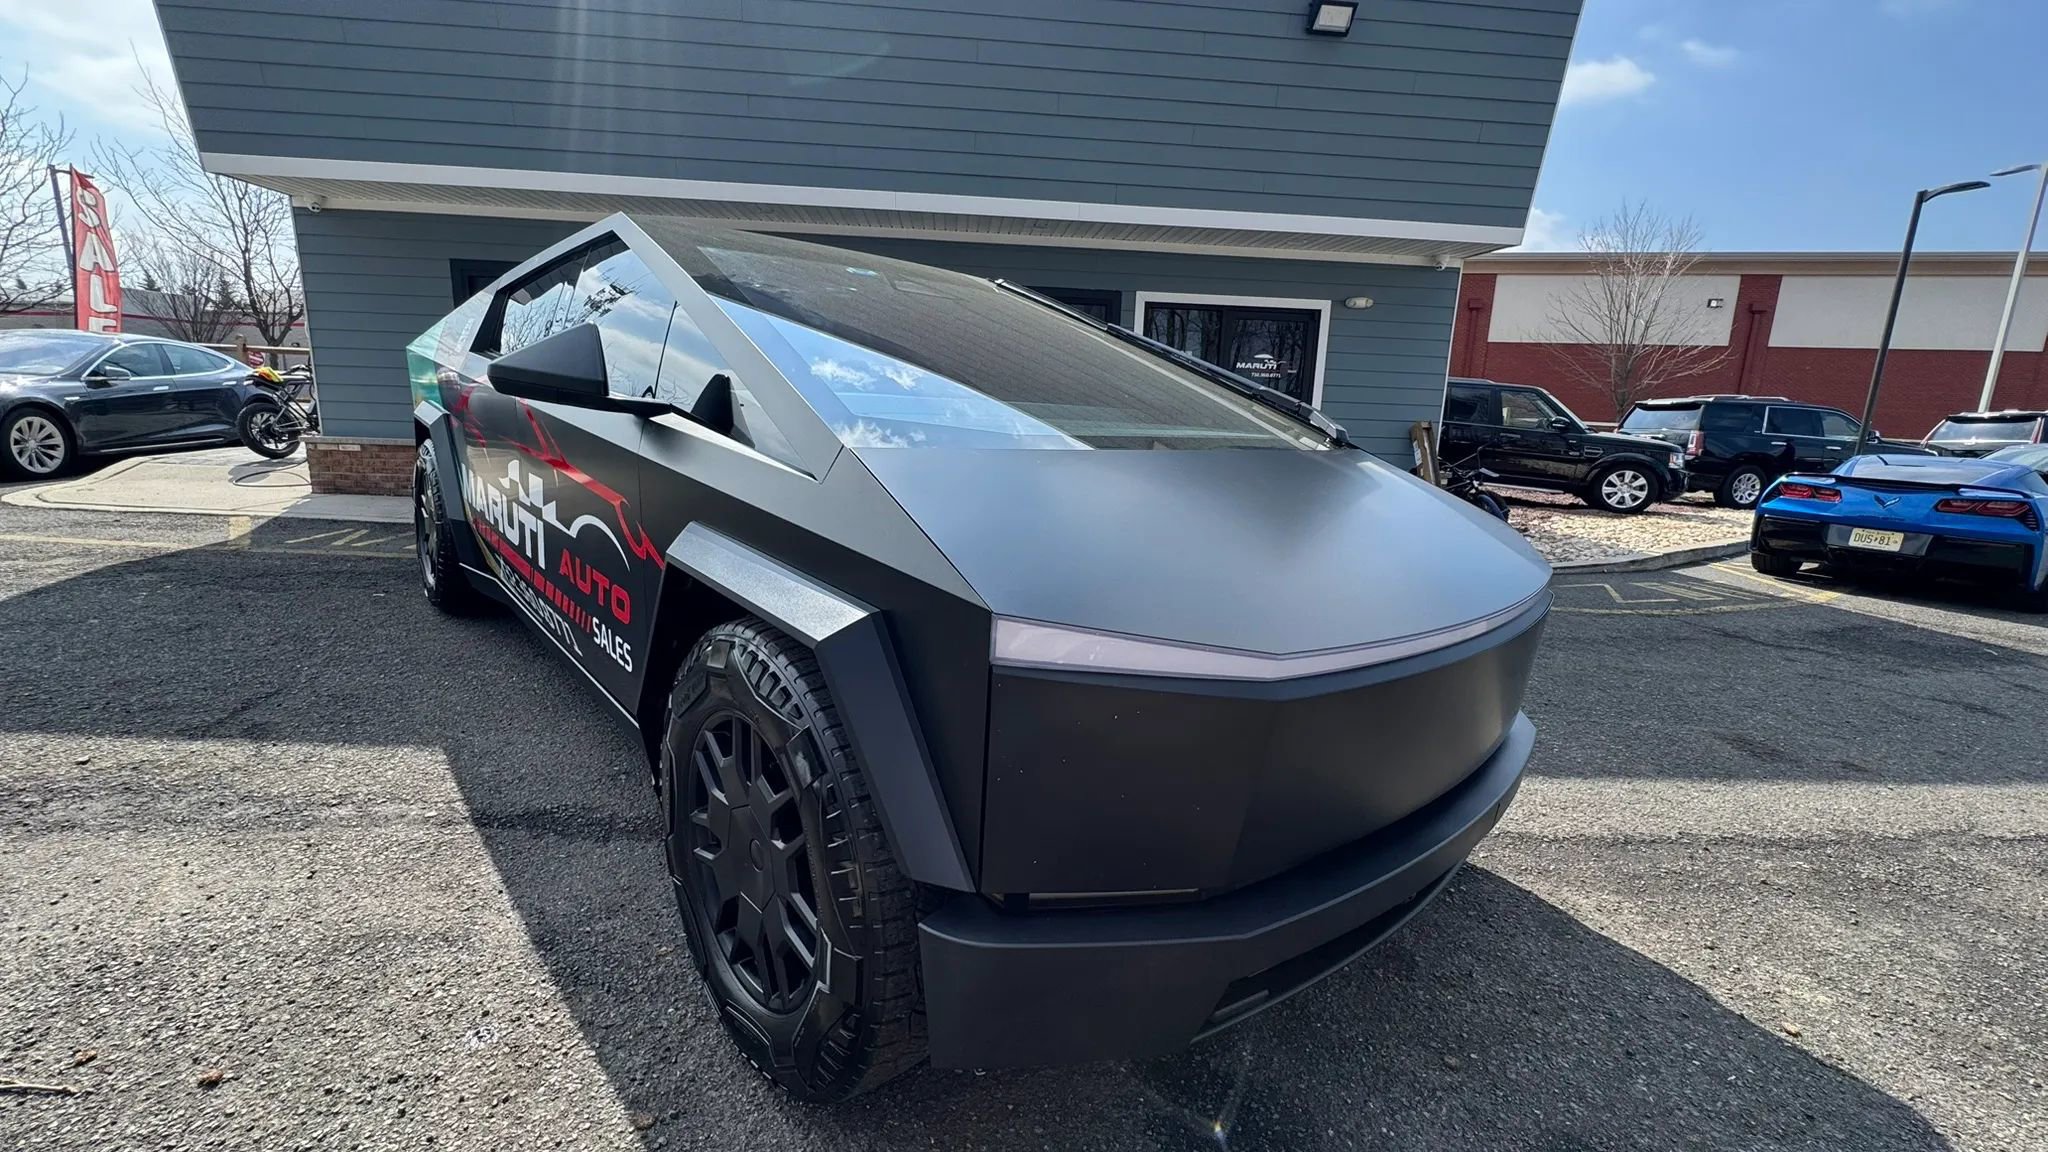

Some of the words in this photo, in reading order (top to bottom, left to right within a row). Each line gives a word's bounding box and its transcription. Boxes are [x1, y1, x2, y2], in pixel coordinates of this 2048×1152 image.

[1236, 362, 1277, 370] MARUTI
[461, 463, 546, 570] MARUTI
[558, 548, 631, 625] AUTO
[592, 616, 633, 673] SALES
